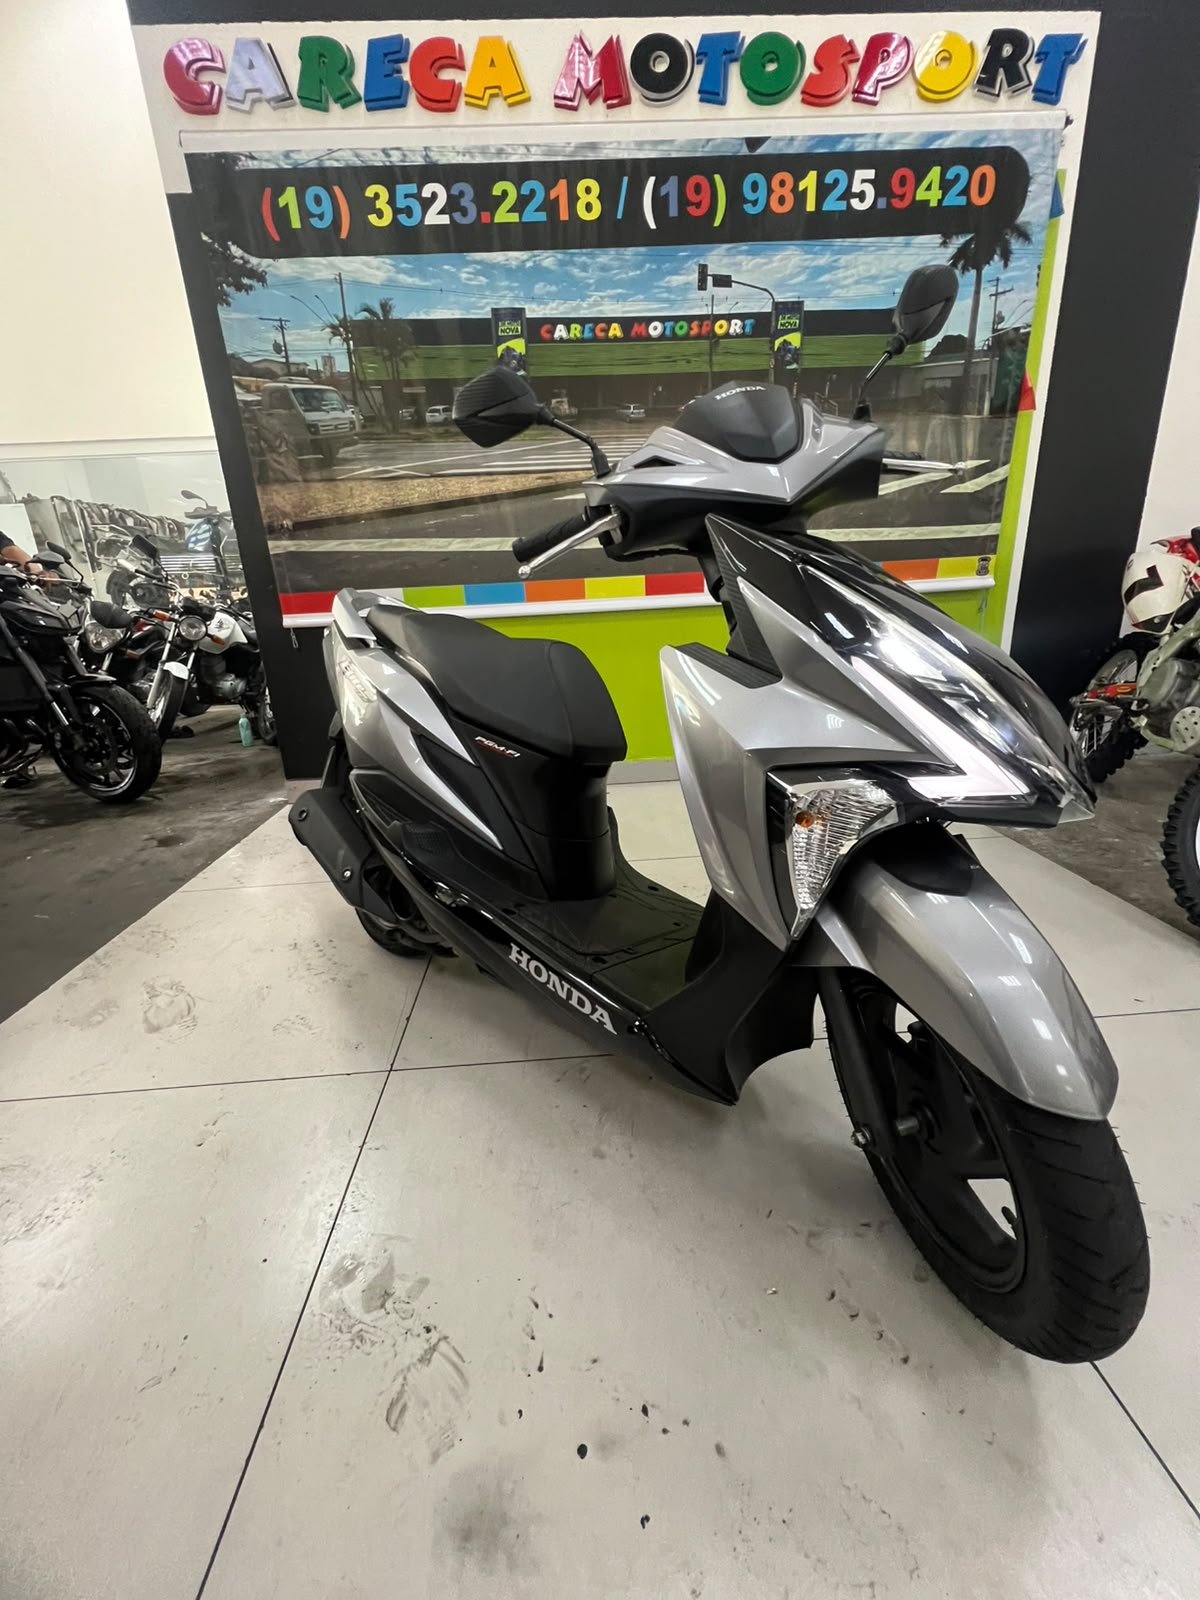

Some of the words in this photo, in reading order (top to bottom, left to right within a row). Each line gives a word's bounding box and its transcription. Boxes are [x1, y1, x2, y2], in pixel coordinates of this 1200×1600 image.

[163, 34, 531, 115] CARECA
[553, 28, 1088, 111] MOTOSPORT
[262, 185, 350, 241] (19)
[365, 178, 602, 227] 3523.2218
[643, 173, 727, 229] (19)
[742, 164, 996, 215] 98125.9420
[540, 322, 624, 340] CARECA
[631, 319, 755, 338] MOTOSPORT
[714, 385, 766, 400] HONDA
[508, 942, 618, 1035] HONDA
